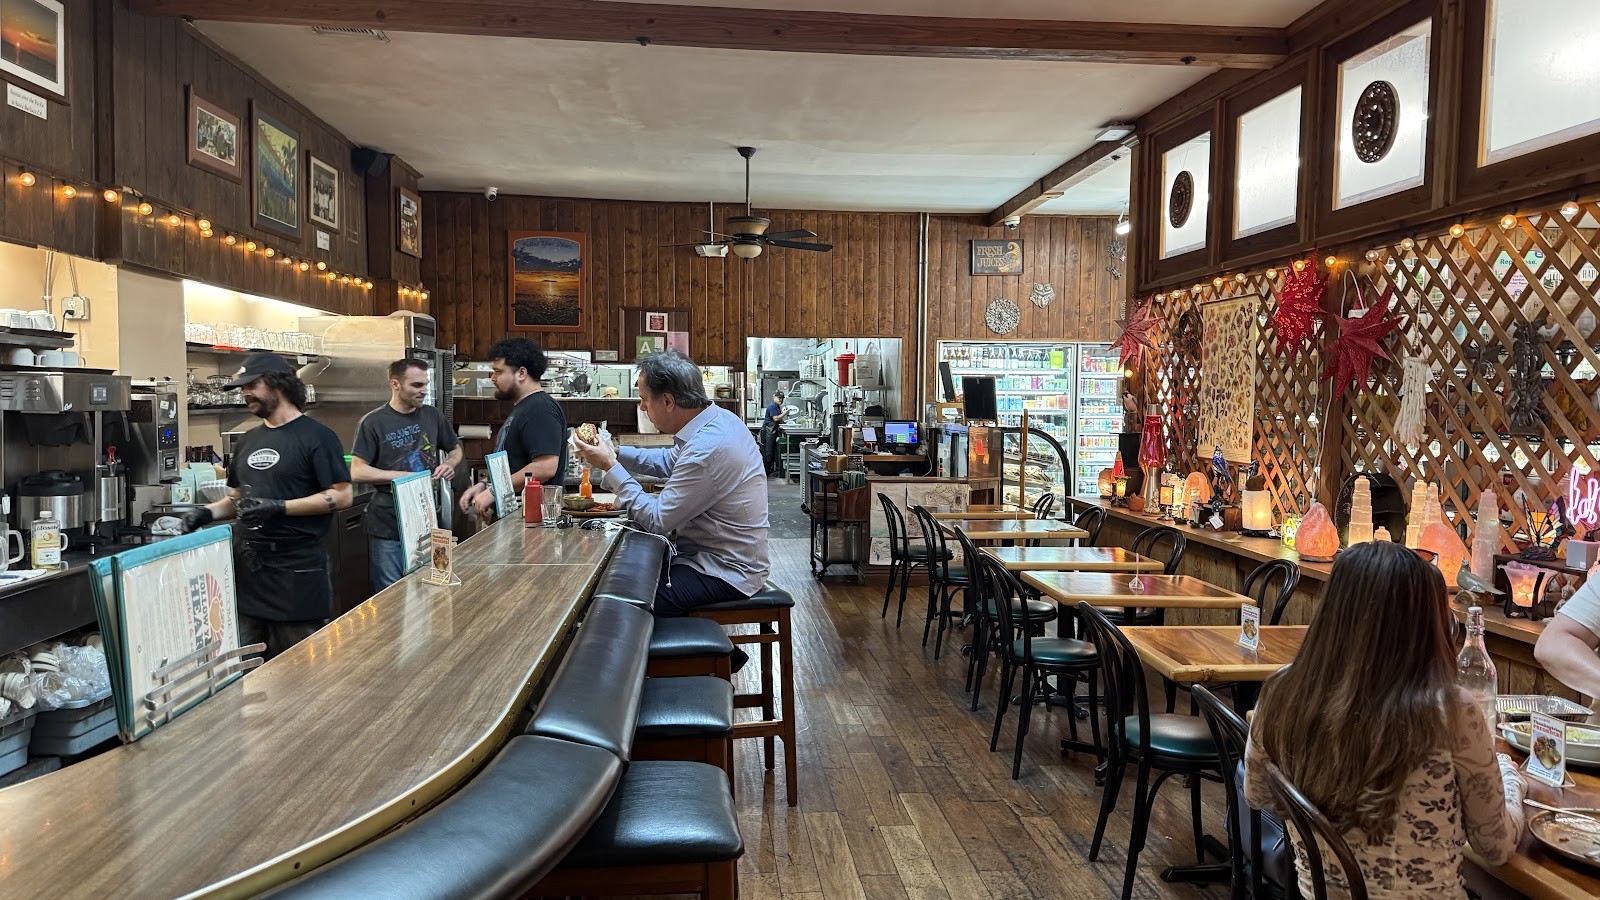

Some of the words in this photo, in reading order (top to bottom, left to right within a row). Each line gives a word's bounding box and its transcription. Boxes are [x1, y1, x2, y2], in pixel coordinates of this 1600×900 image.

[977, 246, 1003, 257] FRESH
[977, 257, 1007, 267] JUICES
[640, 341, 652, 354] A
[199, 574, 209, 627] FOLLOW
